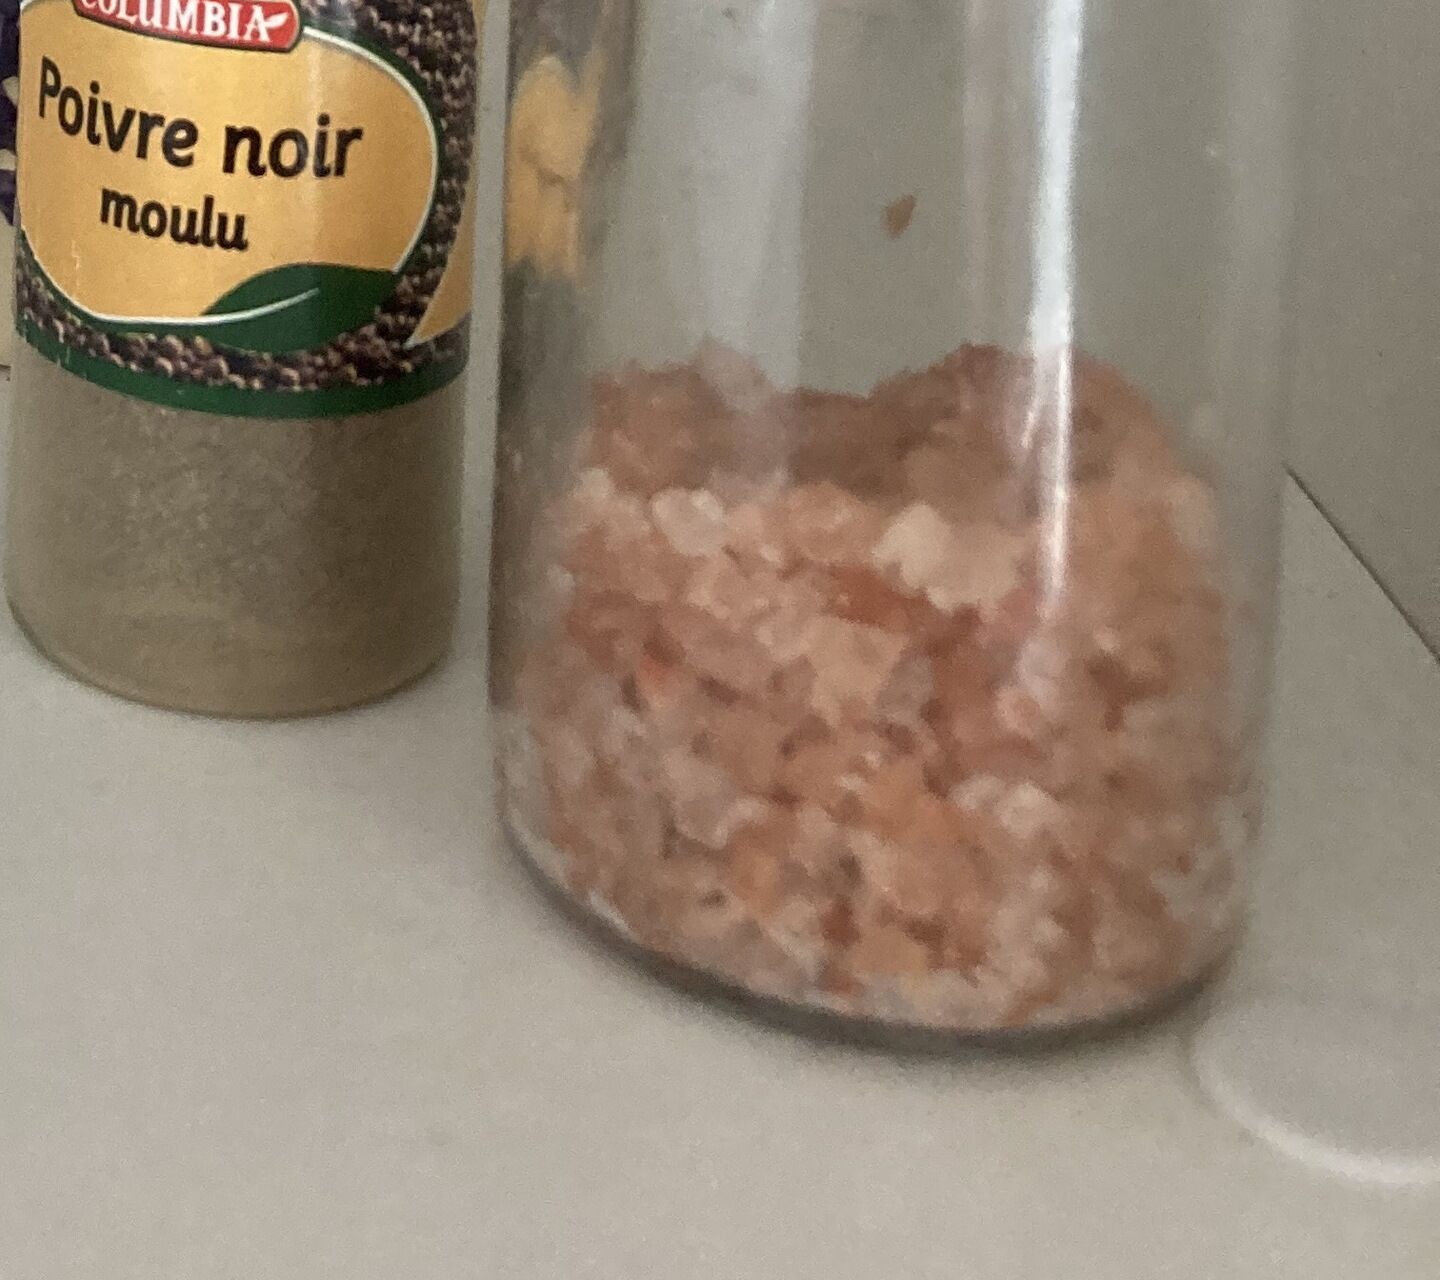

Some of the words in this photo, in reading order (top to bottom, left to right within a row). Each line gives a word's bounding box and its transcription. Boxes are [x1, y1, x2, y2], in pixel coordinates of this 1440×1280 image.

[39, 56, 199, 167] Poivre
[222, 113, 363, 178] noir
[101, 188, 249, 252] moulu
